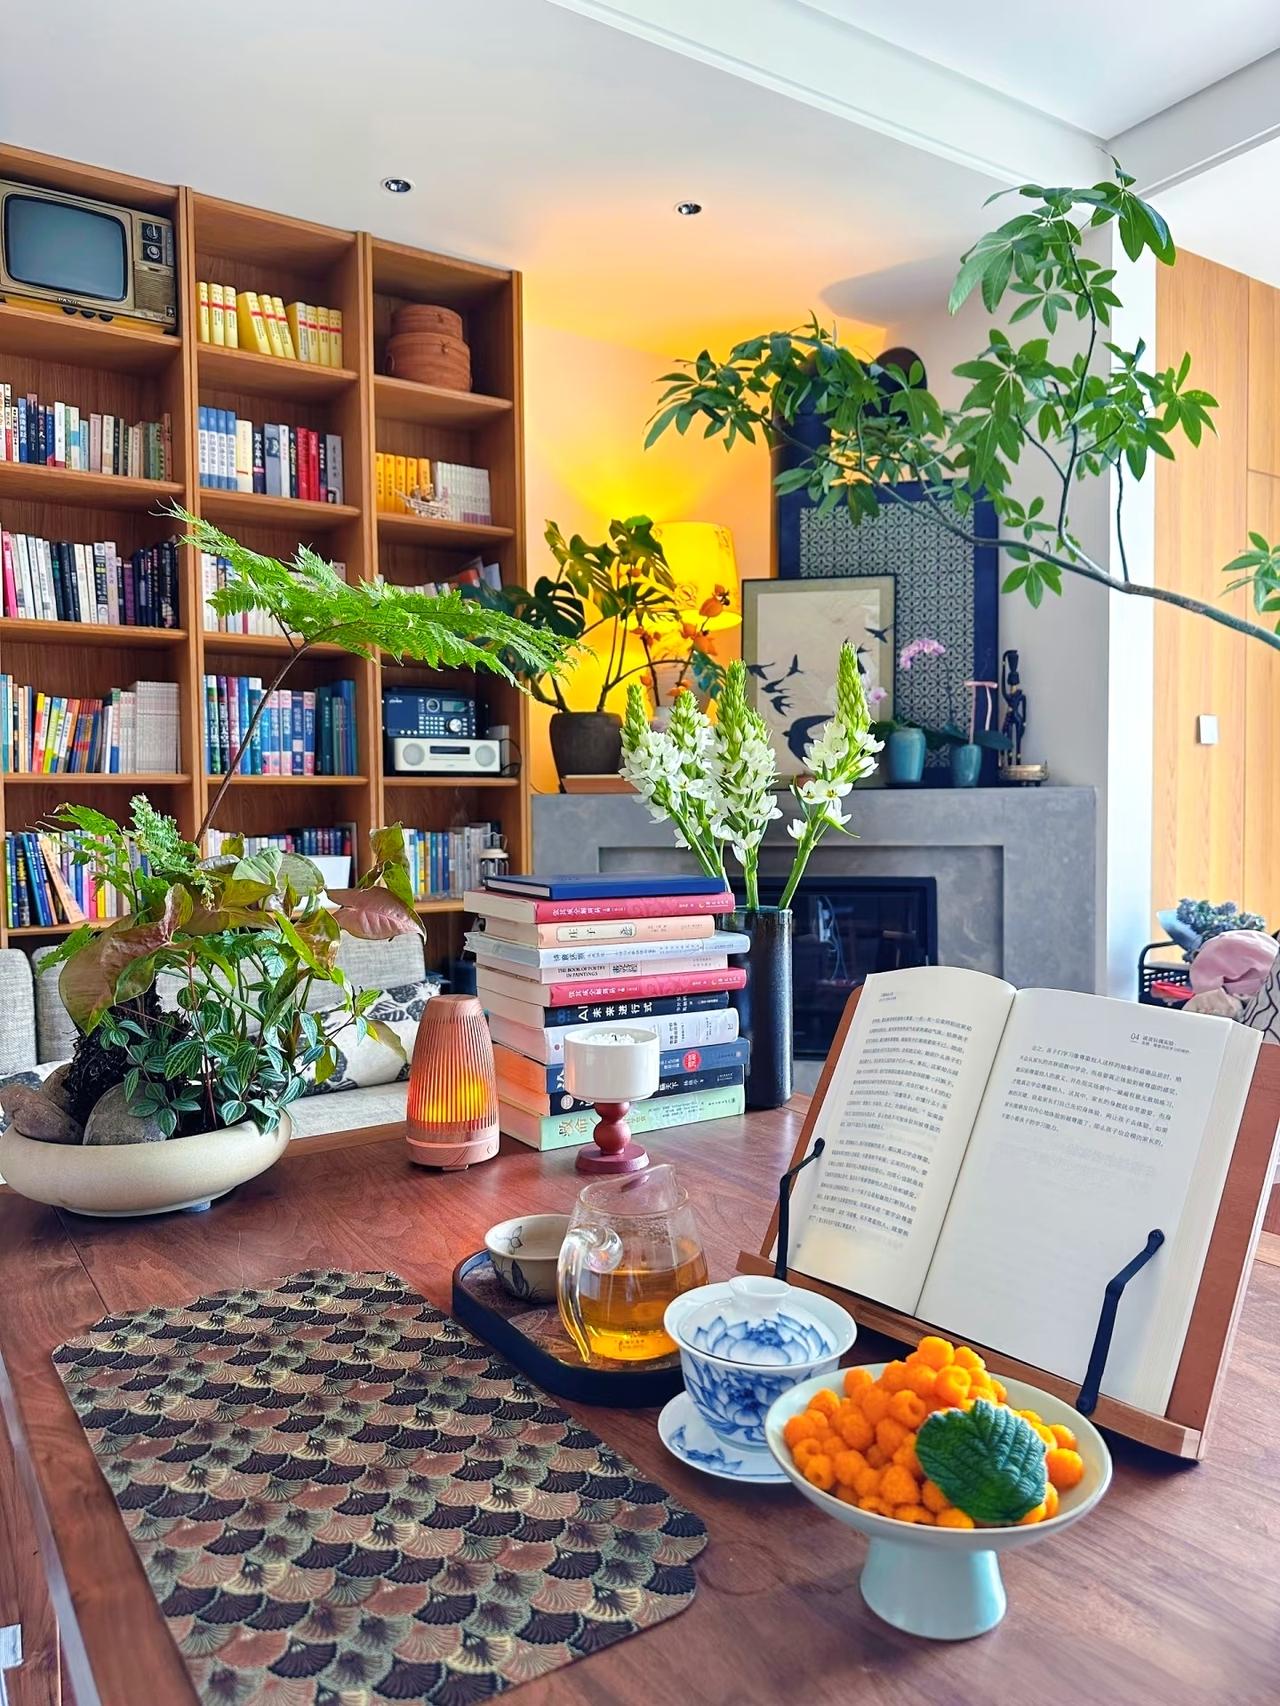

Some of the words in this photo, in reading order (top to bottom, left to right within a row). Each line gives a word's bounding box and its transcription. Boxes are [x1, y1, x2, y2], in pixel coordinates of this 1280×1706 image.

[577, 1001, 653, 1021] AI未来进行式
[1130, 1032, 1141, 1041] 04
